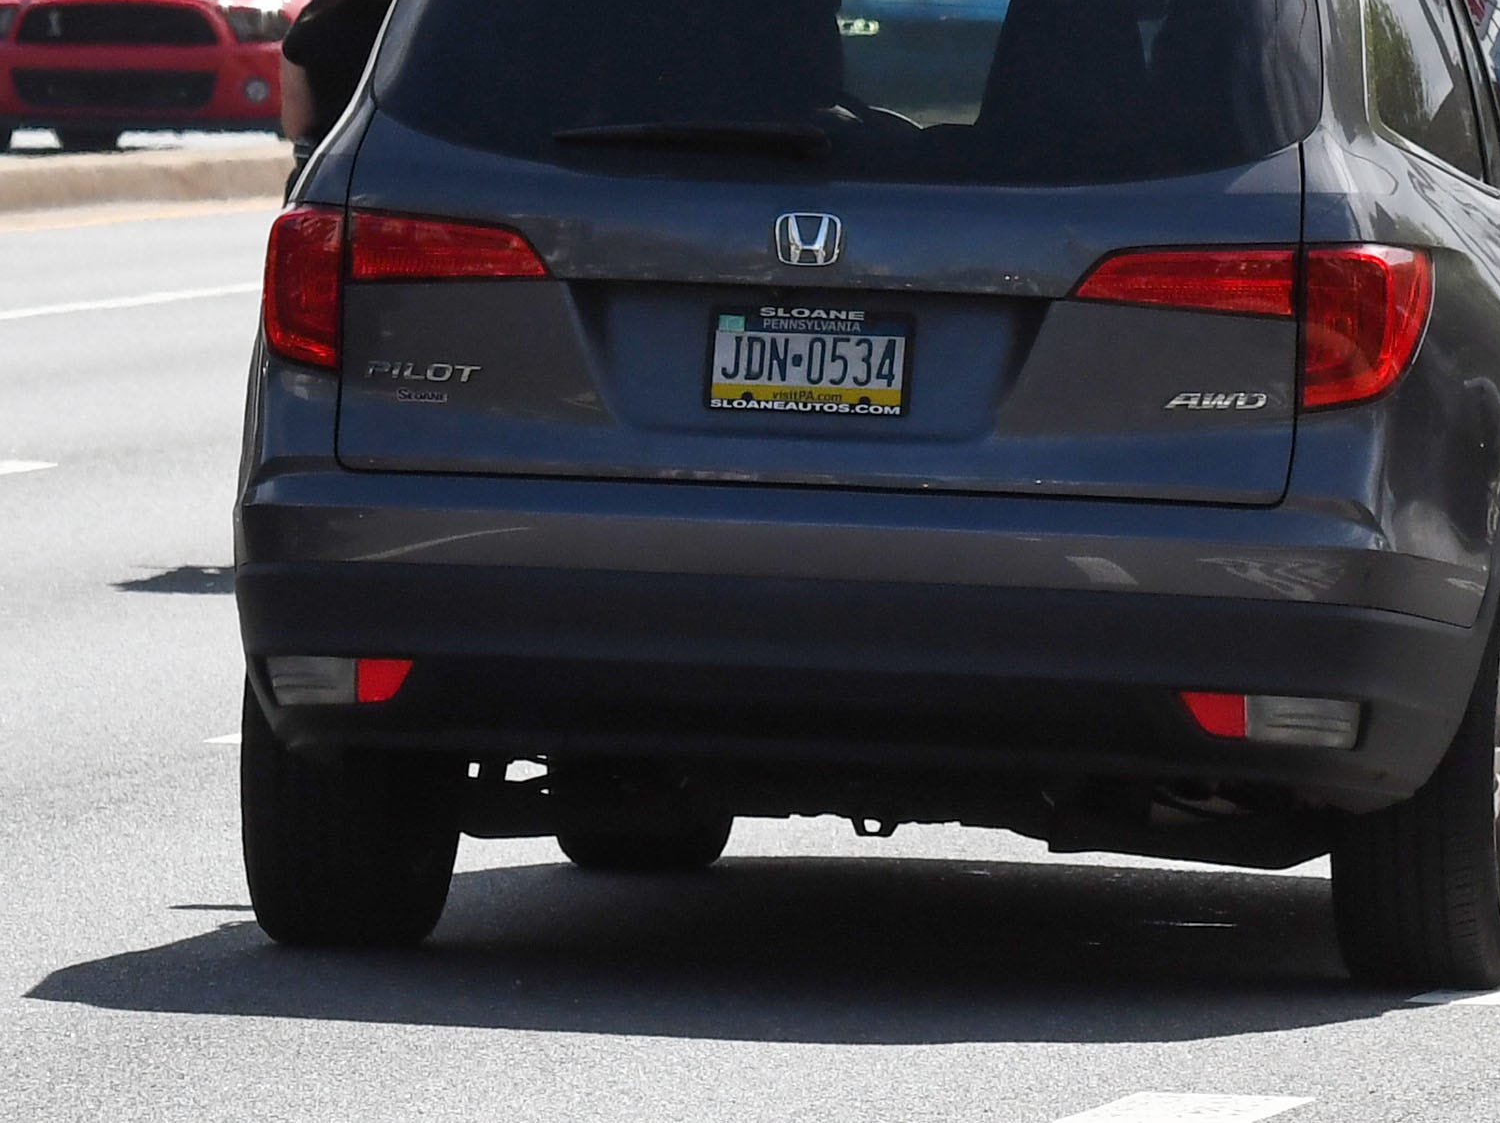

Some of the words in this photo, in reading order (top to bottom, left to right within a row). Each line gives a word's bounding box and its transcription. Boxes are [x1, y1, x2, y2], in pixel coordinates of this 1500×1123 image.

[760, 306, 866, 322] SLOANE
[762, 318, 862, 333] PENNSYLVANIA
[365, 360, 482, 383] PILOT
[772, 389, 843, 403] visitPA.com
[1163, 392, 1267, 410] AWD
[710, 399, 901, 416] SLOANEAUTOS.COM
